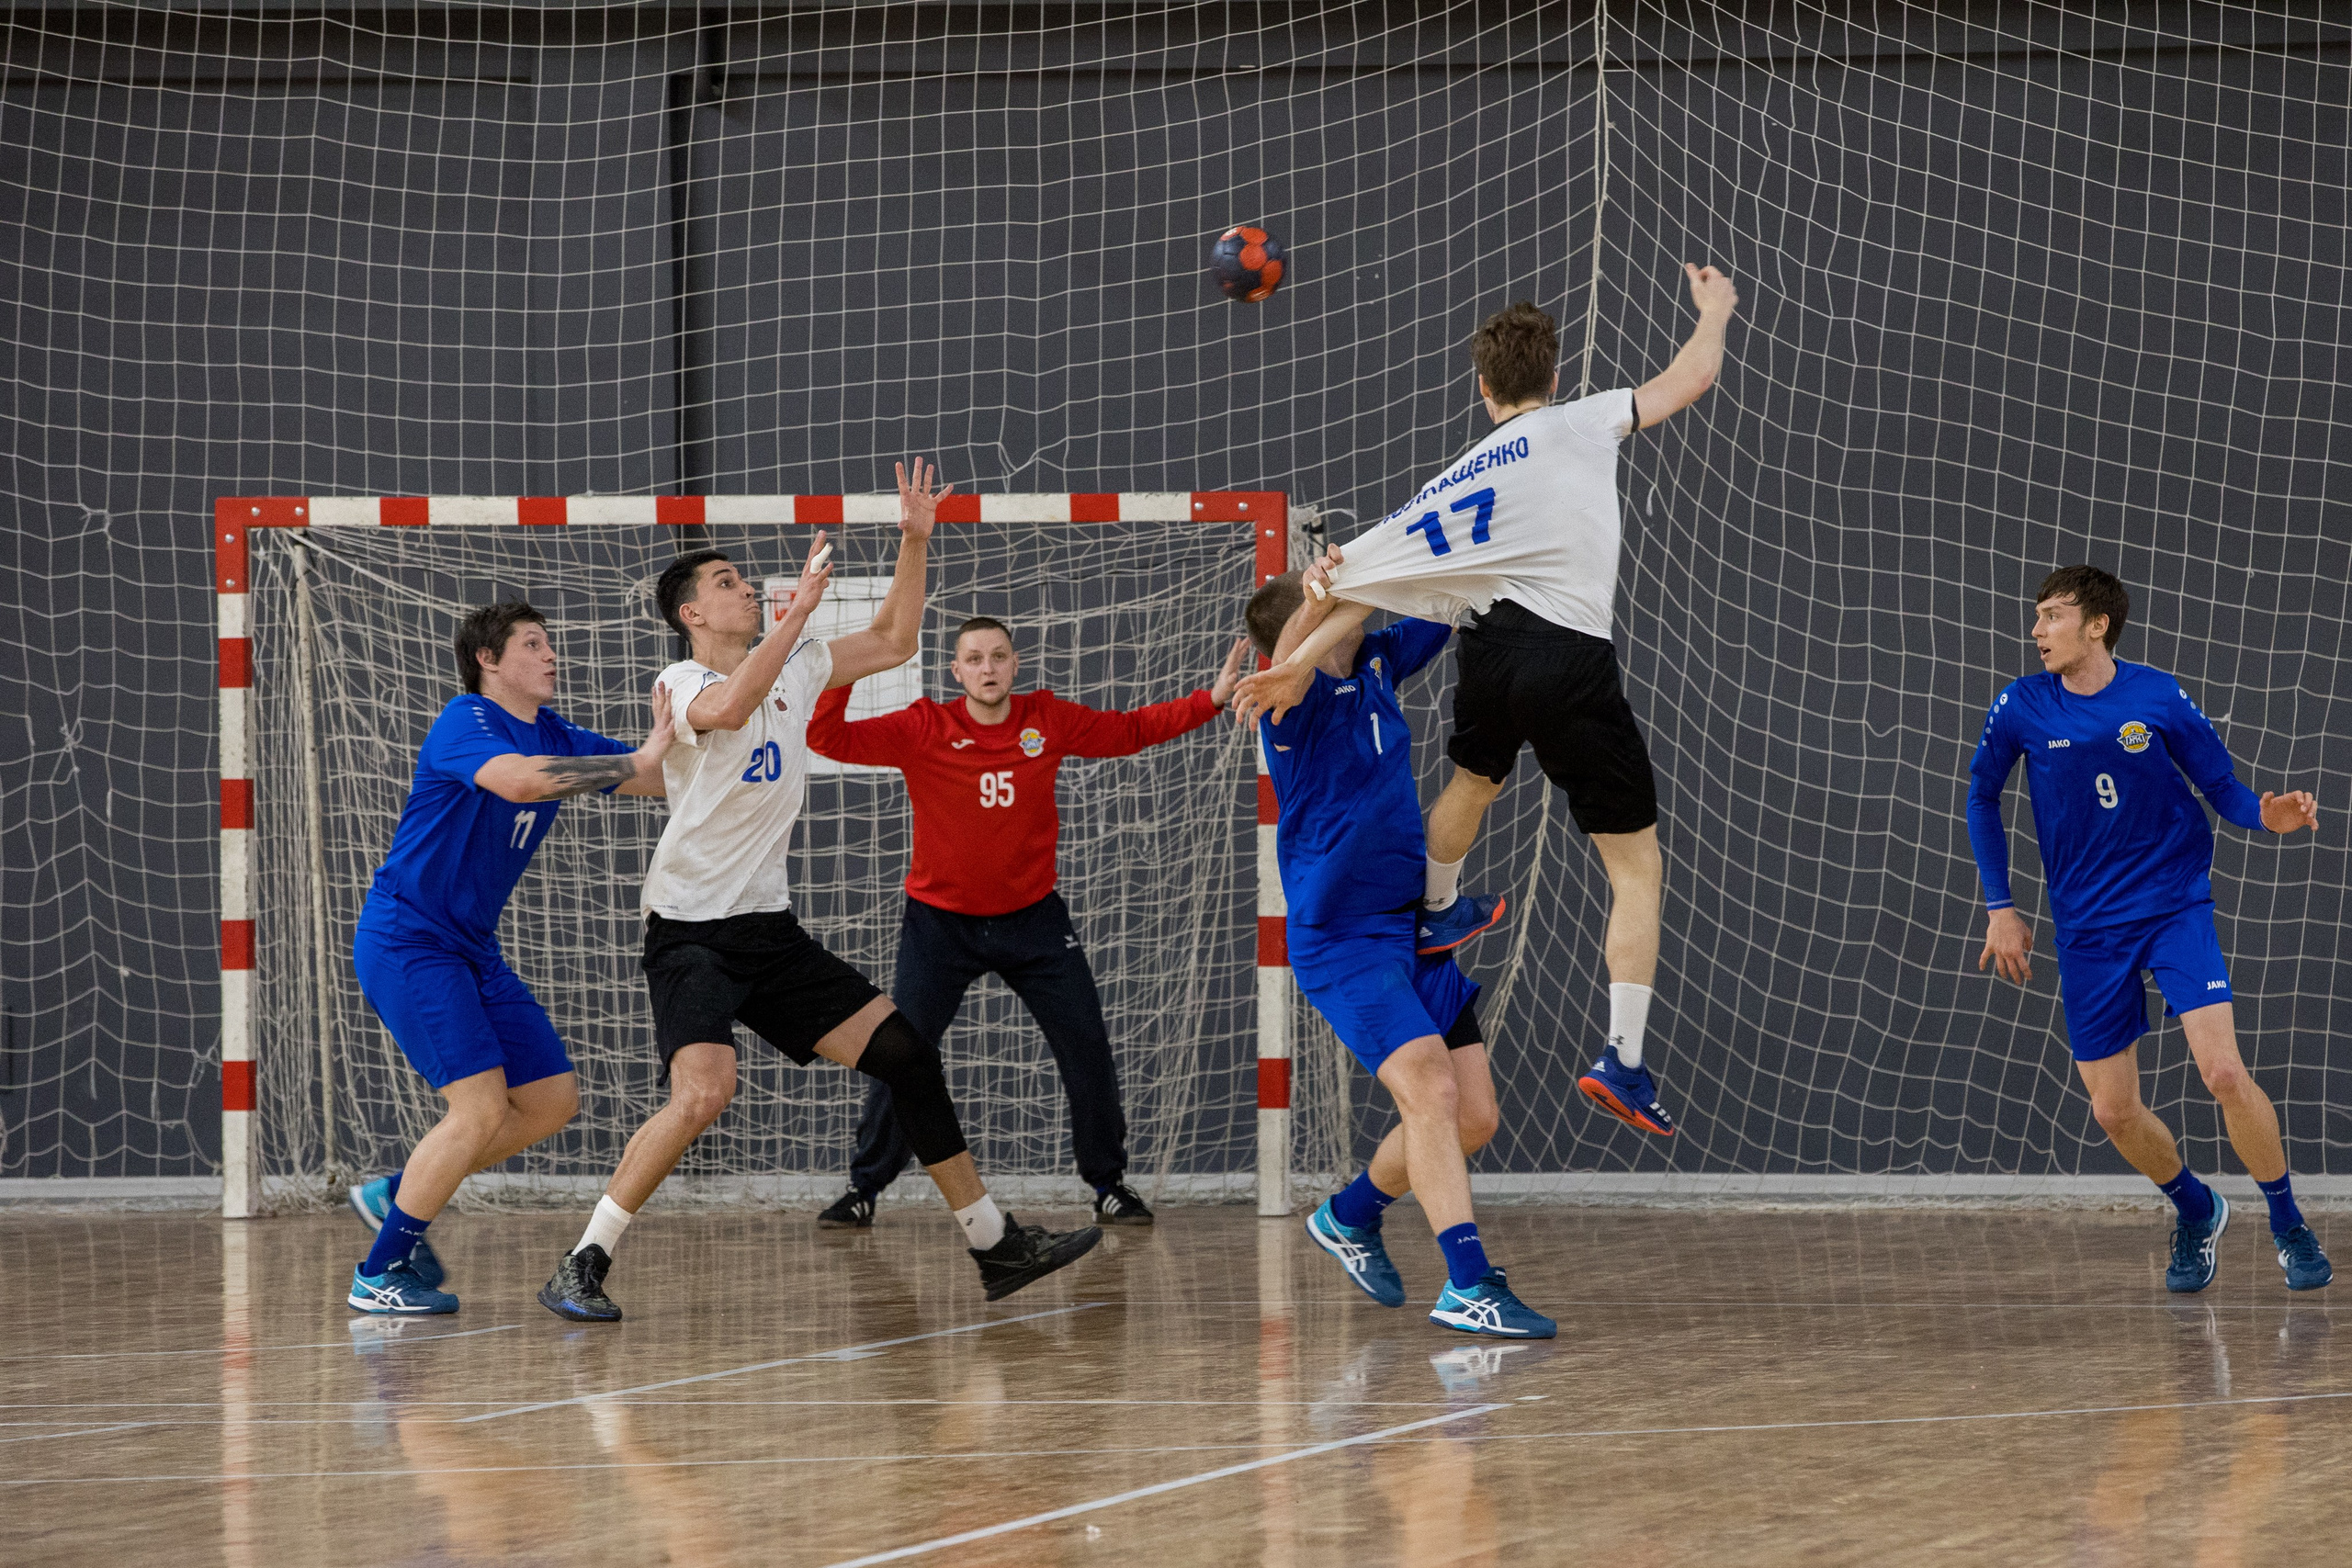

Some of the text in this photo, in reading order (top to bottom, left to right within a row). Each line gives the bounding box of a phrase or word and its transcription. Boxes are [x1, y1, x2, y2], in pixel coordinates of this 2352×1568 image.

[1406, 487, 1496, 557] 17
[1370, 712, 1383, 755] 1
[2048, 739, 2071, 749] JAKO
[741, 740, 781, 783] 20
[979, 771, 1015, 808] 95
[2096, 773, 2119, 808] 9
[2207, 979, 2227, 990] JAKO
